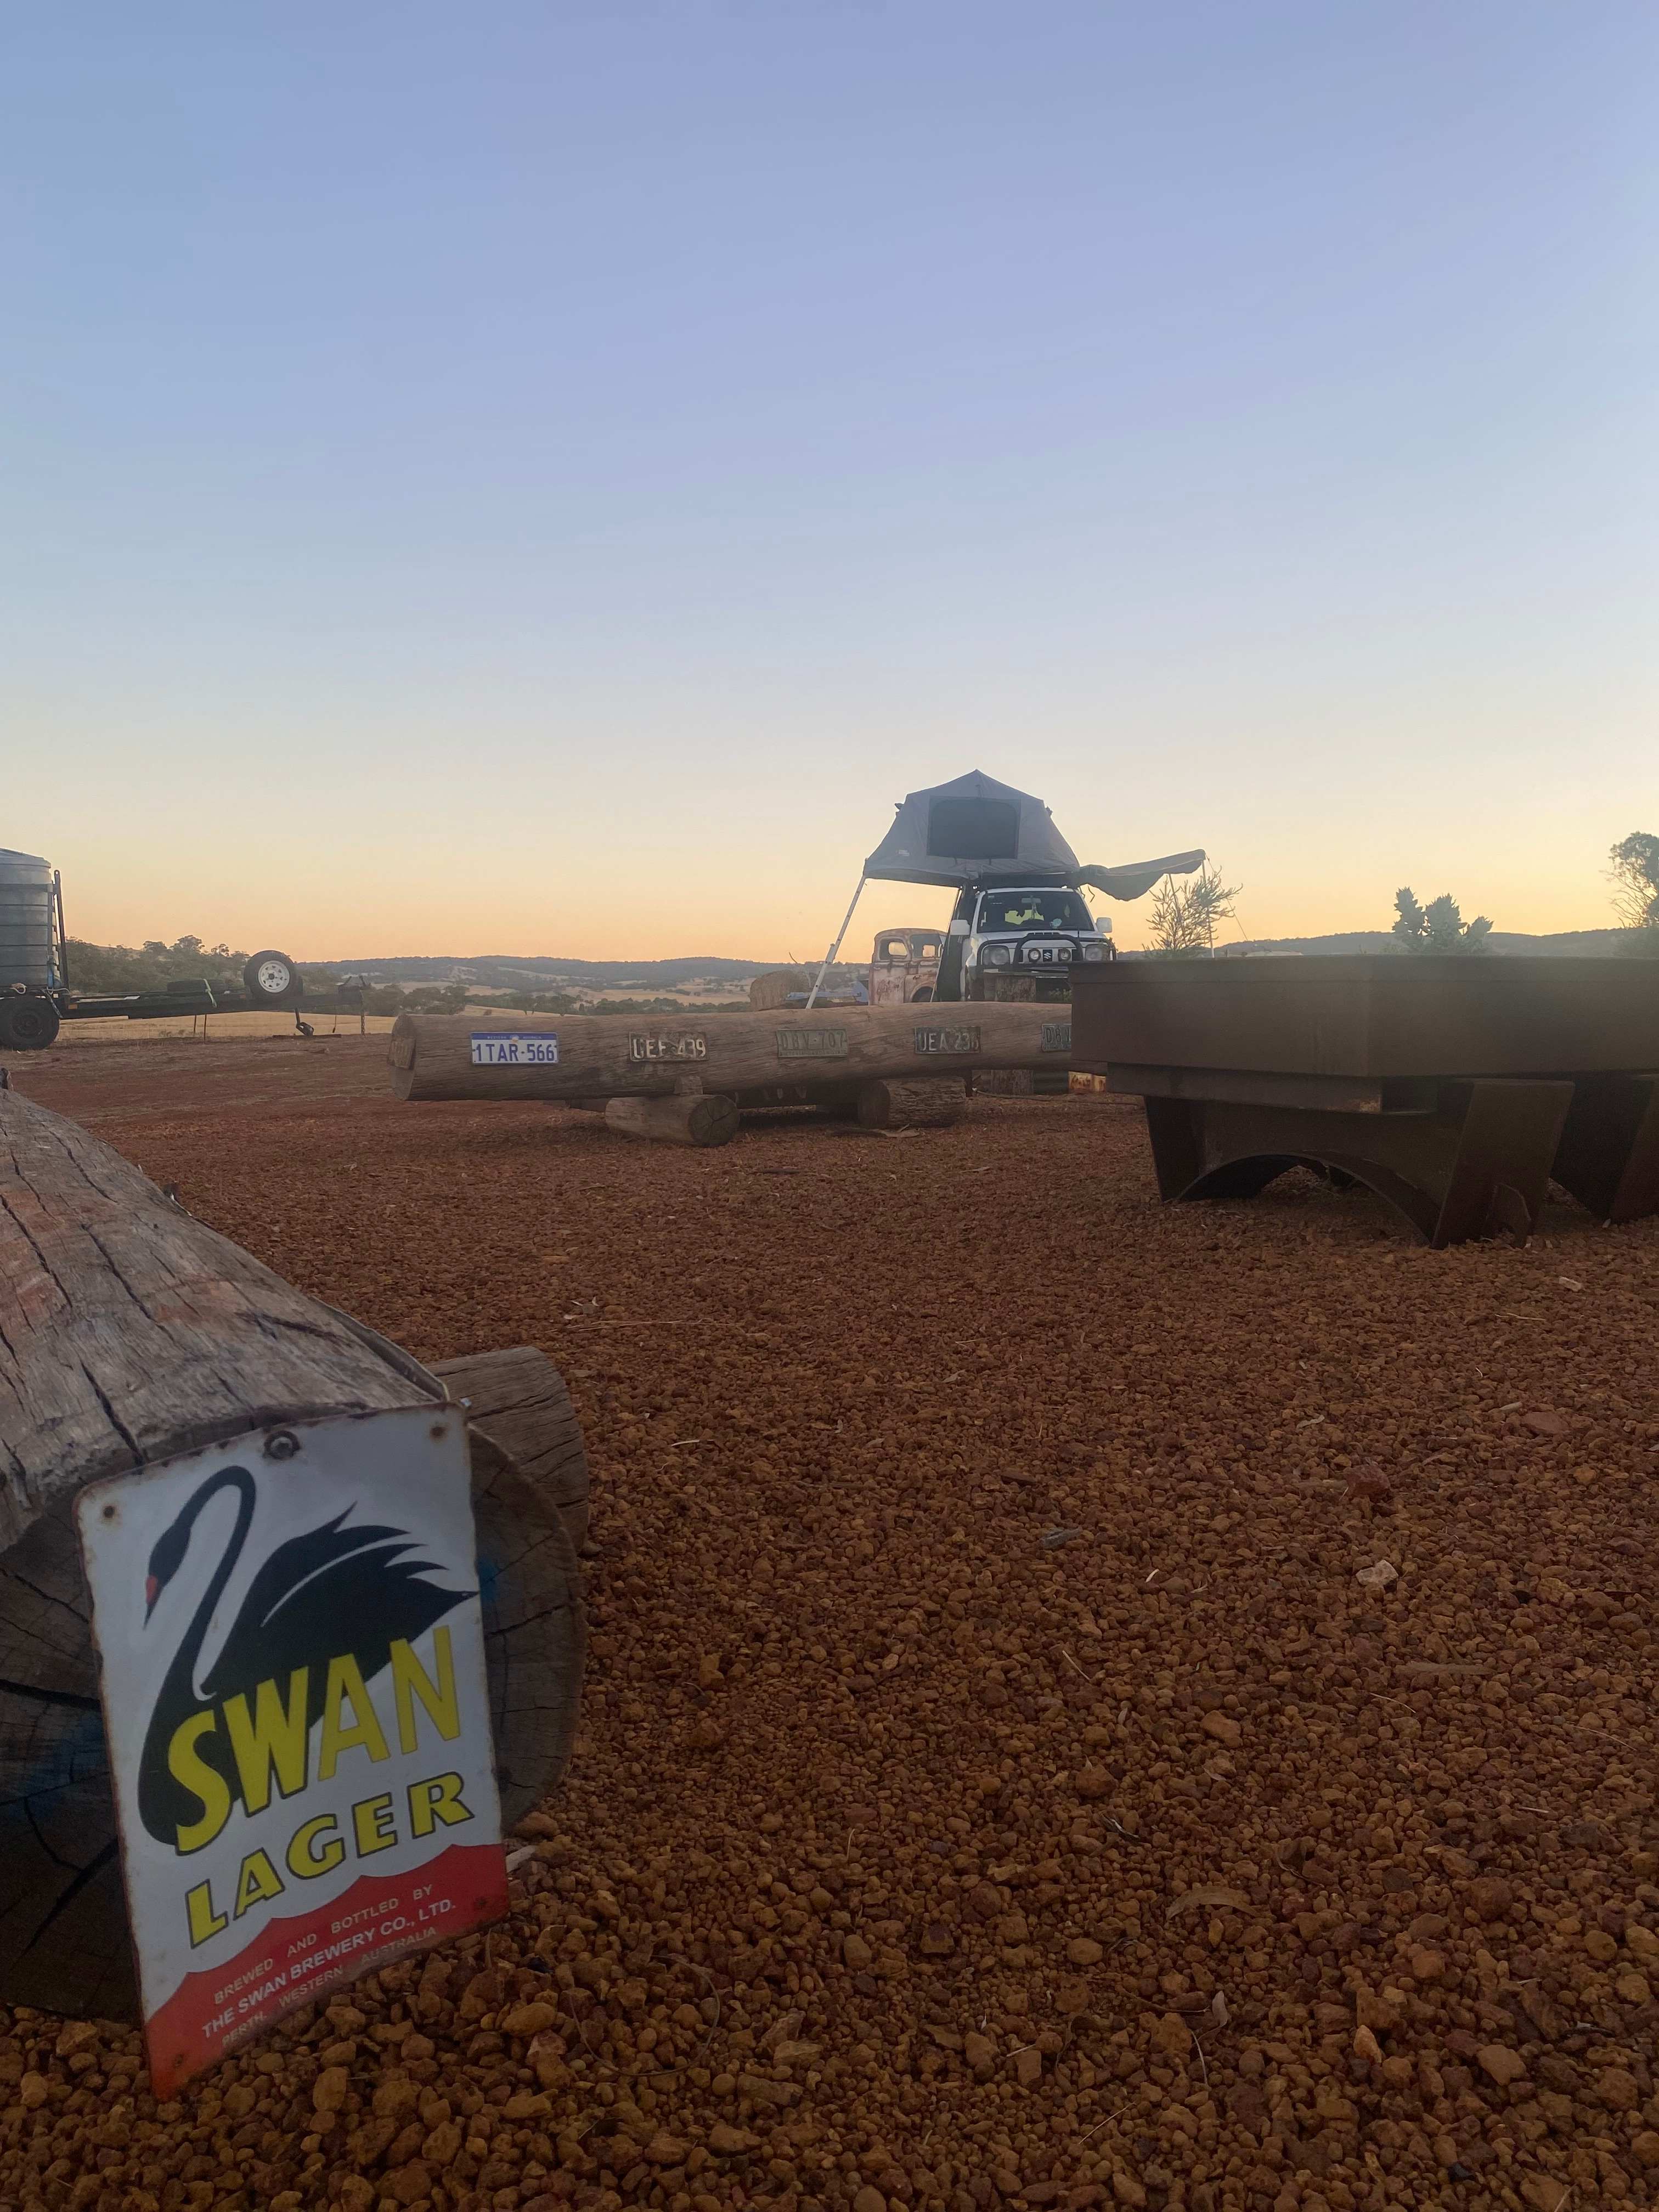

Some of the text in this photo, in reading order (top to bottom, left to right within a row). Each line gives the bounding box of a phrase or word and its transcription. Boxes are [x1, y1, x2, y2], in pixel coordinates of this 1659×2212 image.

[168, 1624, 461, 1856] SWAN
[184, 1770, 475, 1949] LAGER
[202, 2007, 234, 2038] THE
[238, 1972, 286, 2013] SWAN
[290, 1927, 375, 1979] BREWERY
[419, 1899, 456, 1921] LTD.
[213, 1884, 432, 2005] BREWED AND BOTTLED BY
[279, 1964, 343, 2007] WESTERN
[360, 1926, 437, 1965] AUSTRALIA
